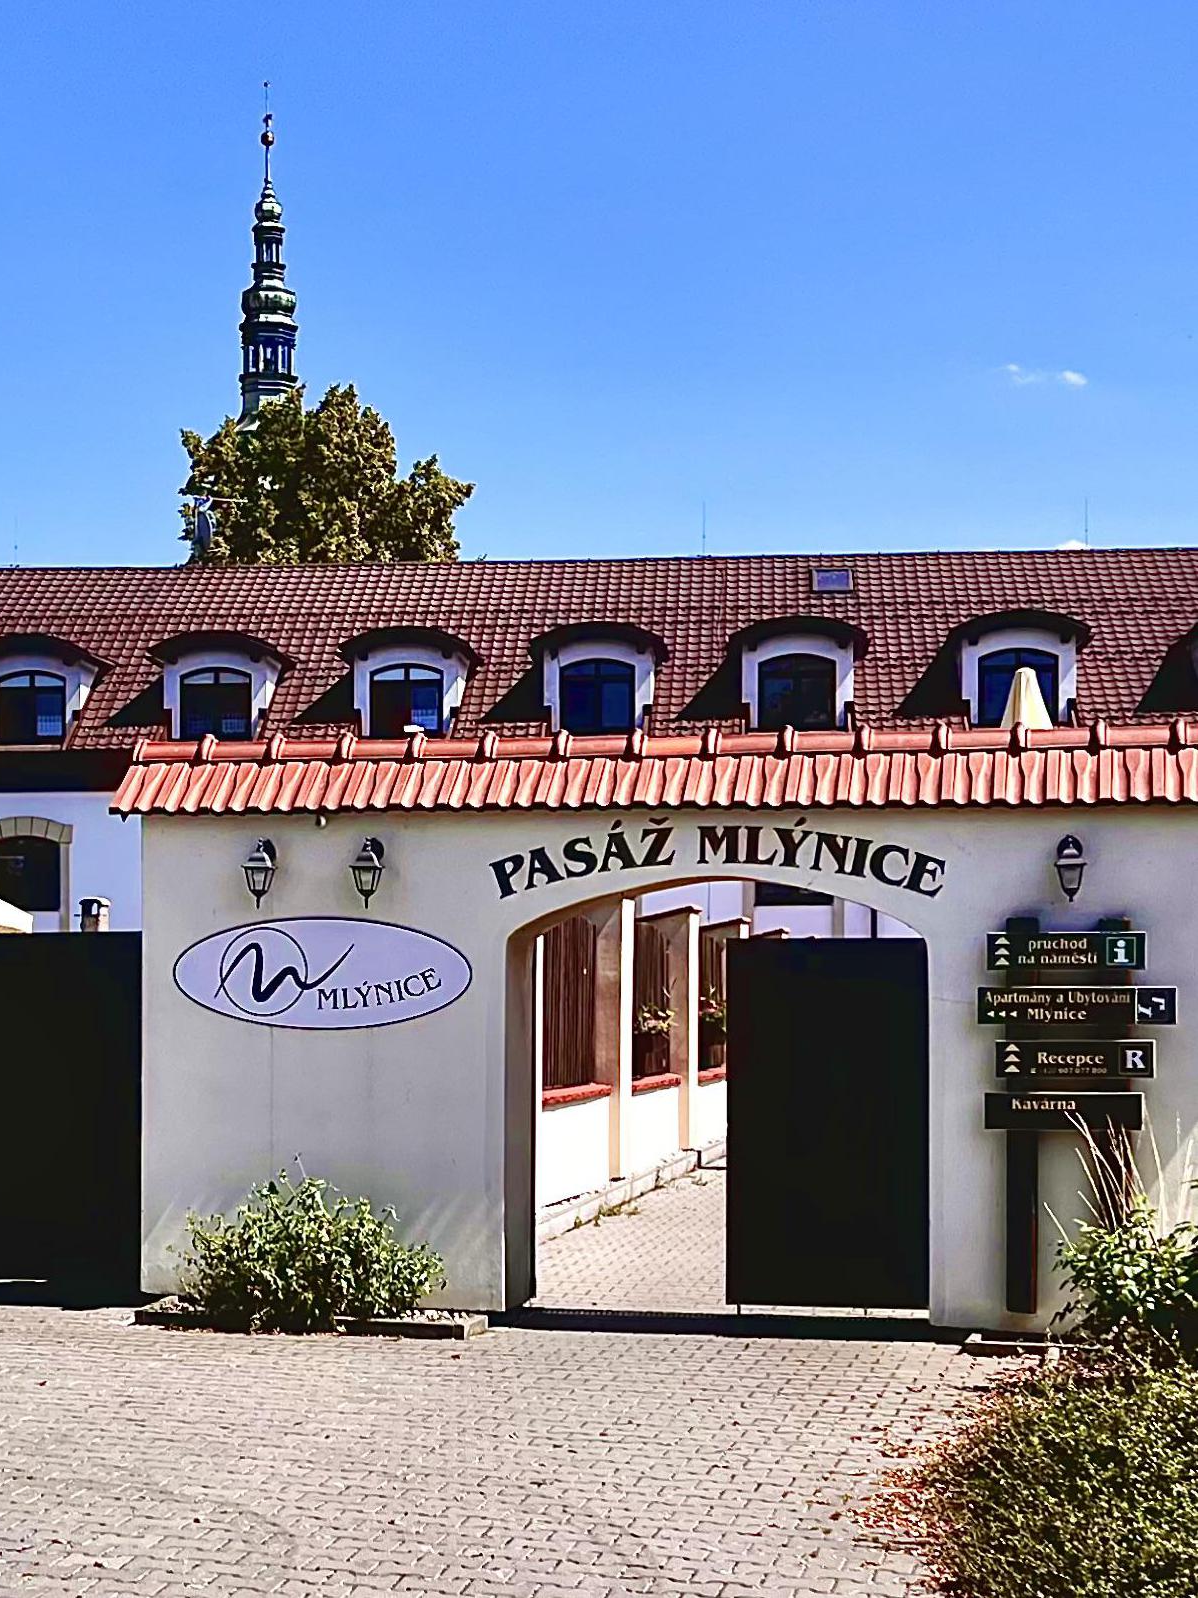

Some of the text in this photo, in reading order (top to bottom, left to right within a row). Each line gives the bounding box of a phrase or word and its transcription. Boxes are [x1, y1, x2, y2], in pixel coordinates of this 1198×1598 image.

[489, 816, 946, 899] PASÁŽ MLÝNICE
[1018, 954, 1035, 965] na
[317, 967, 443, 1010] MLÝNICE
[985, 991, 1052, 1006] Apartmány
[1056, 994, 1065, 1004] a
[1037, 1051, 1105, 1067] Recepce
[1124, 1050, 1147, 1069] R
[1011, 1097, 1077, 1110] Kavárna
